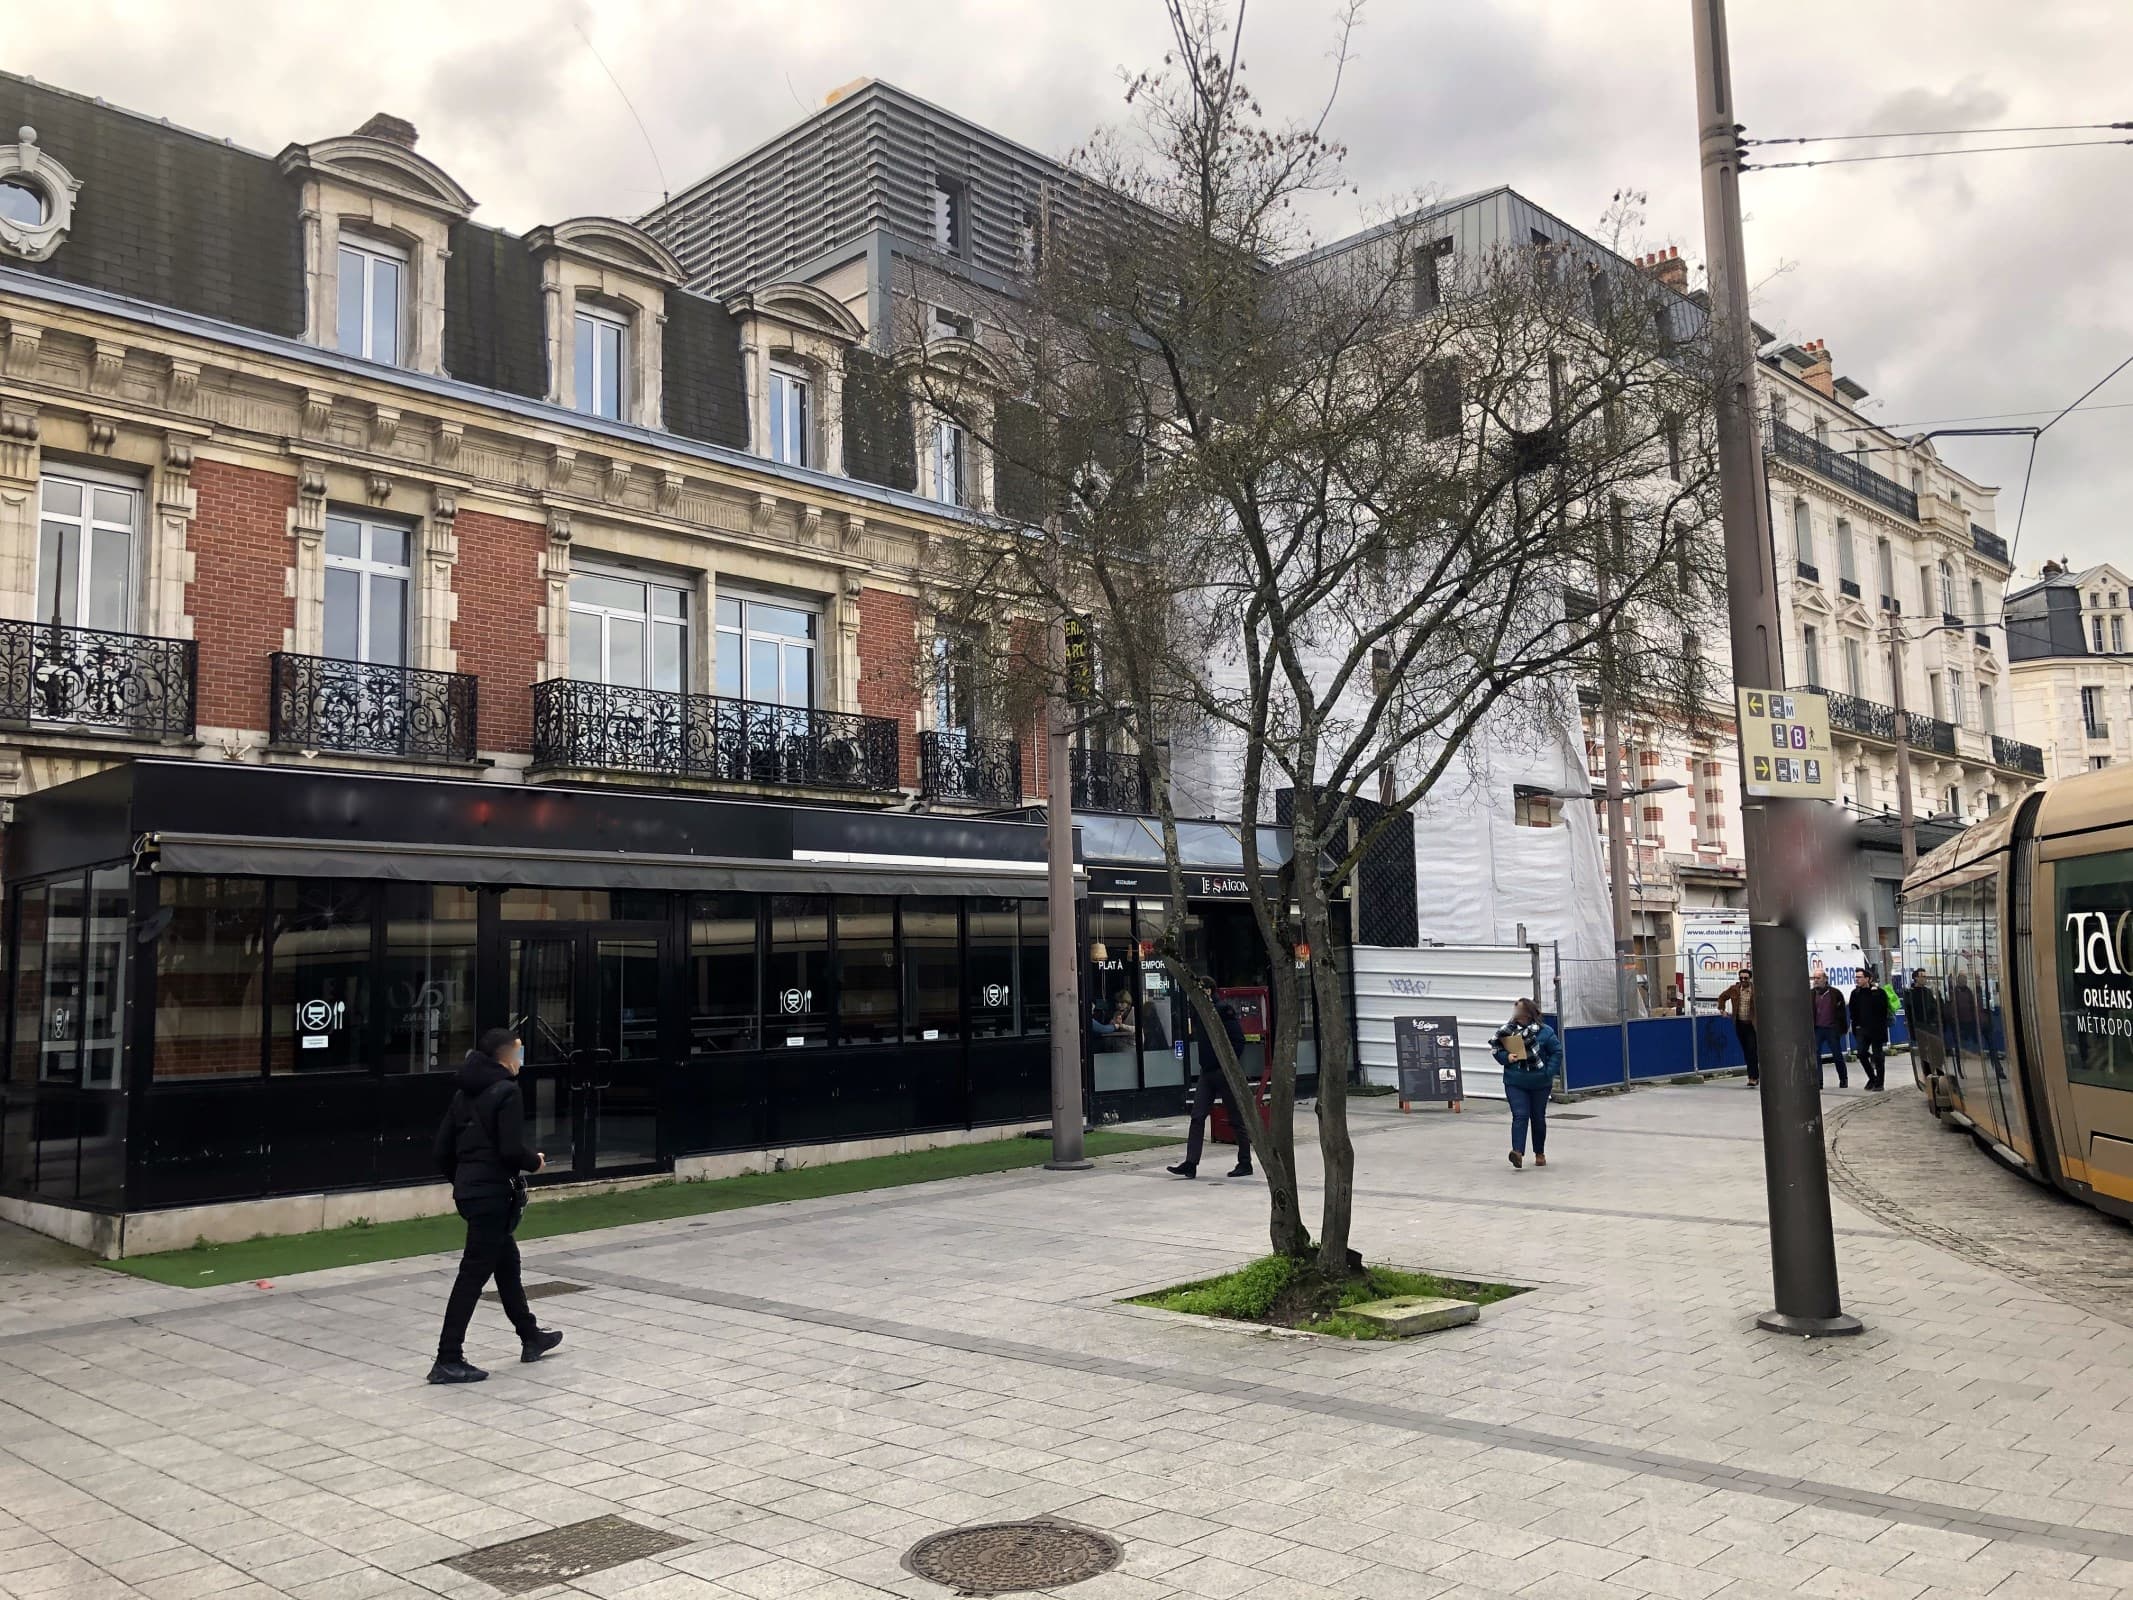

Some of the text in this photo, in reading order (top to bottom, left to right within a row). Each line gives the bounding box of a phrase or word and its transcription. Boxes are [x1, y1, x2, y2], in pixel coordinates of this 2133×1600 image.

[1786, 705, 1794, 717] M
[1794, 728, 1803, 747] B
[1792, 768, 1800, 780] N
[1202, 877, 1210, 894] LE
[1098, 960, 1116, 970] PLAT
[2083, 984, 2133, 1010] ORLÉANS
